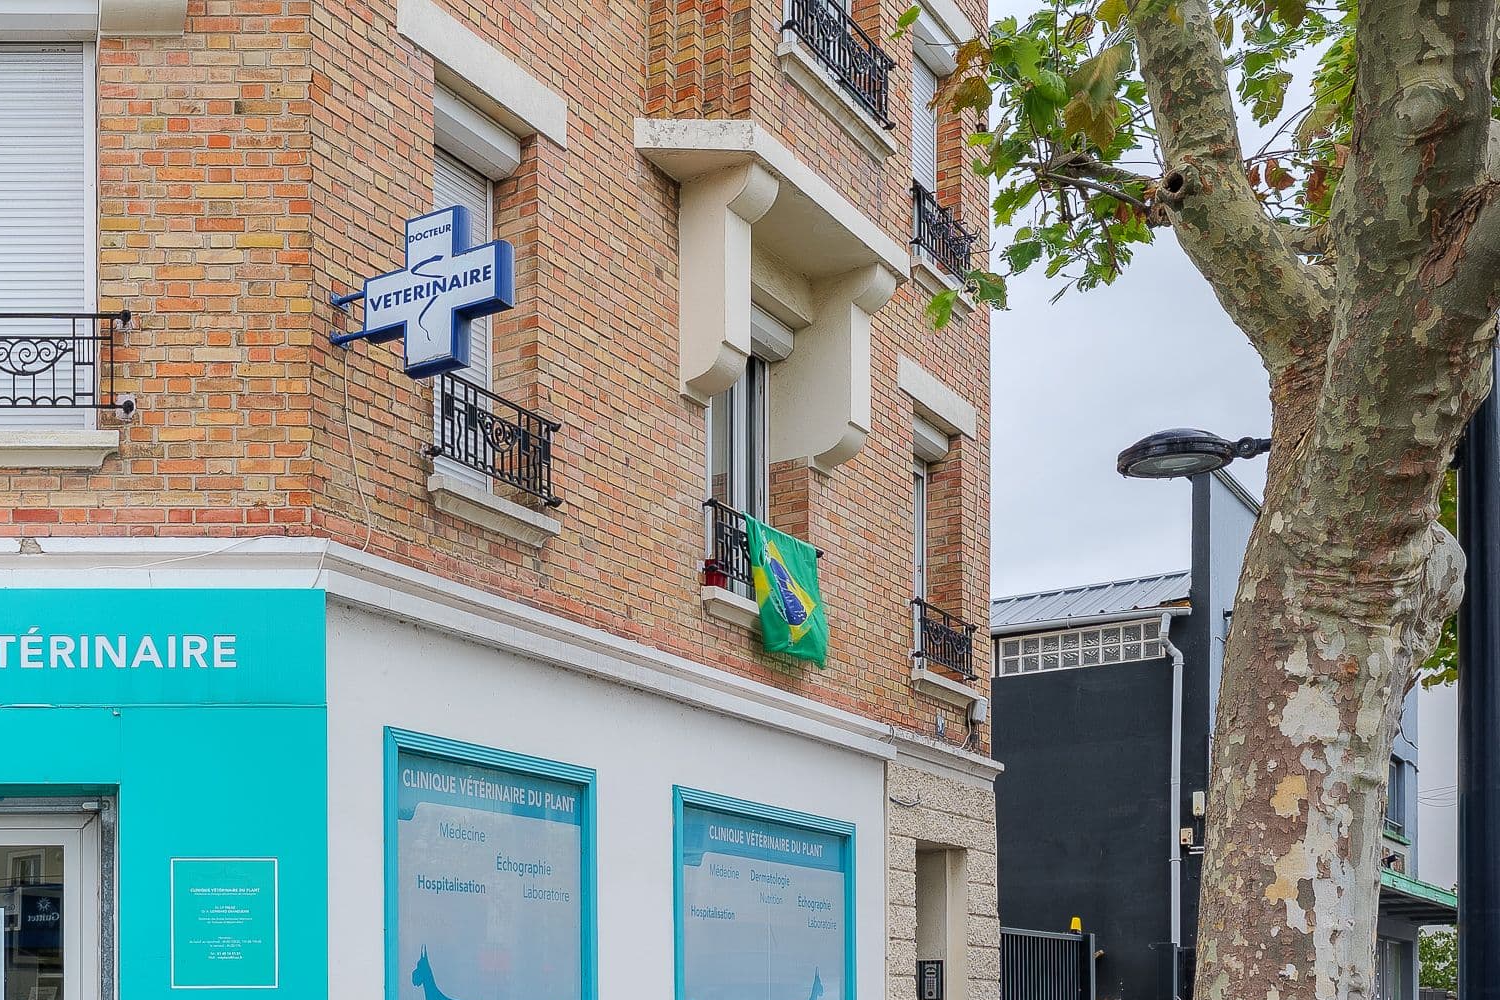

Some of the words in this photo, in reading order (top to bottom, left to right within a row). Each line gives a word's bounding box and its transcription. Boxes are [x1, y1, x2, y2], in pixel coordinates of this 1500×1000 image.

[408, 223, 451, 243] DOCTEUR
[369, 264, 492, 312] VETERINAIRE
[402, 768, 456, 794] CLINIQUE
[459, 775, 526, 805] VÉTÉRINAIRE
[528, 789, 542, 808] DU
[545, 794, 575, 813] PLANT
[439, 822, 486, 843] Médecine
[709, 825, 744, 844] CLINIQUE
[745, 829, 790, 852] VÉTÉRINAIRE
[791, 841, 801, 855] DU
[802, 841, 823, 858] PLANT
[496, 852, 552, 878] Échographie
[417, 874, 486, 895] Hospitalisation
[709, 863, 740, 880] Médecine
[750, 869, 791, 889] Dermatologie
[523, 884, 570, 903] Laboratoire
[797, 893, 832, 912] Échographie
[690, 905, 736, 921] Hospitalisation
[807, 917, 837, 931] Laboratoire
